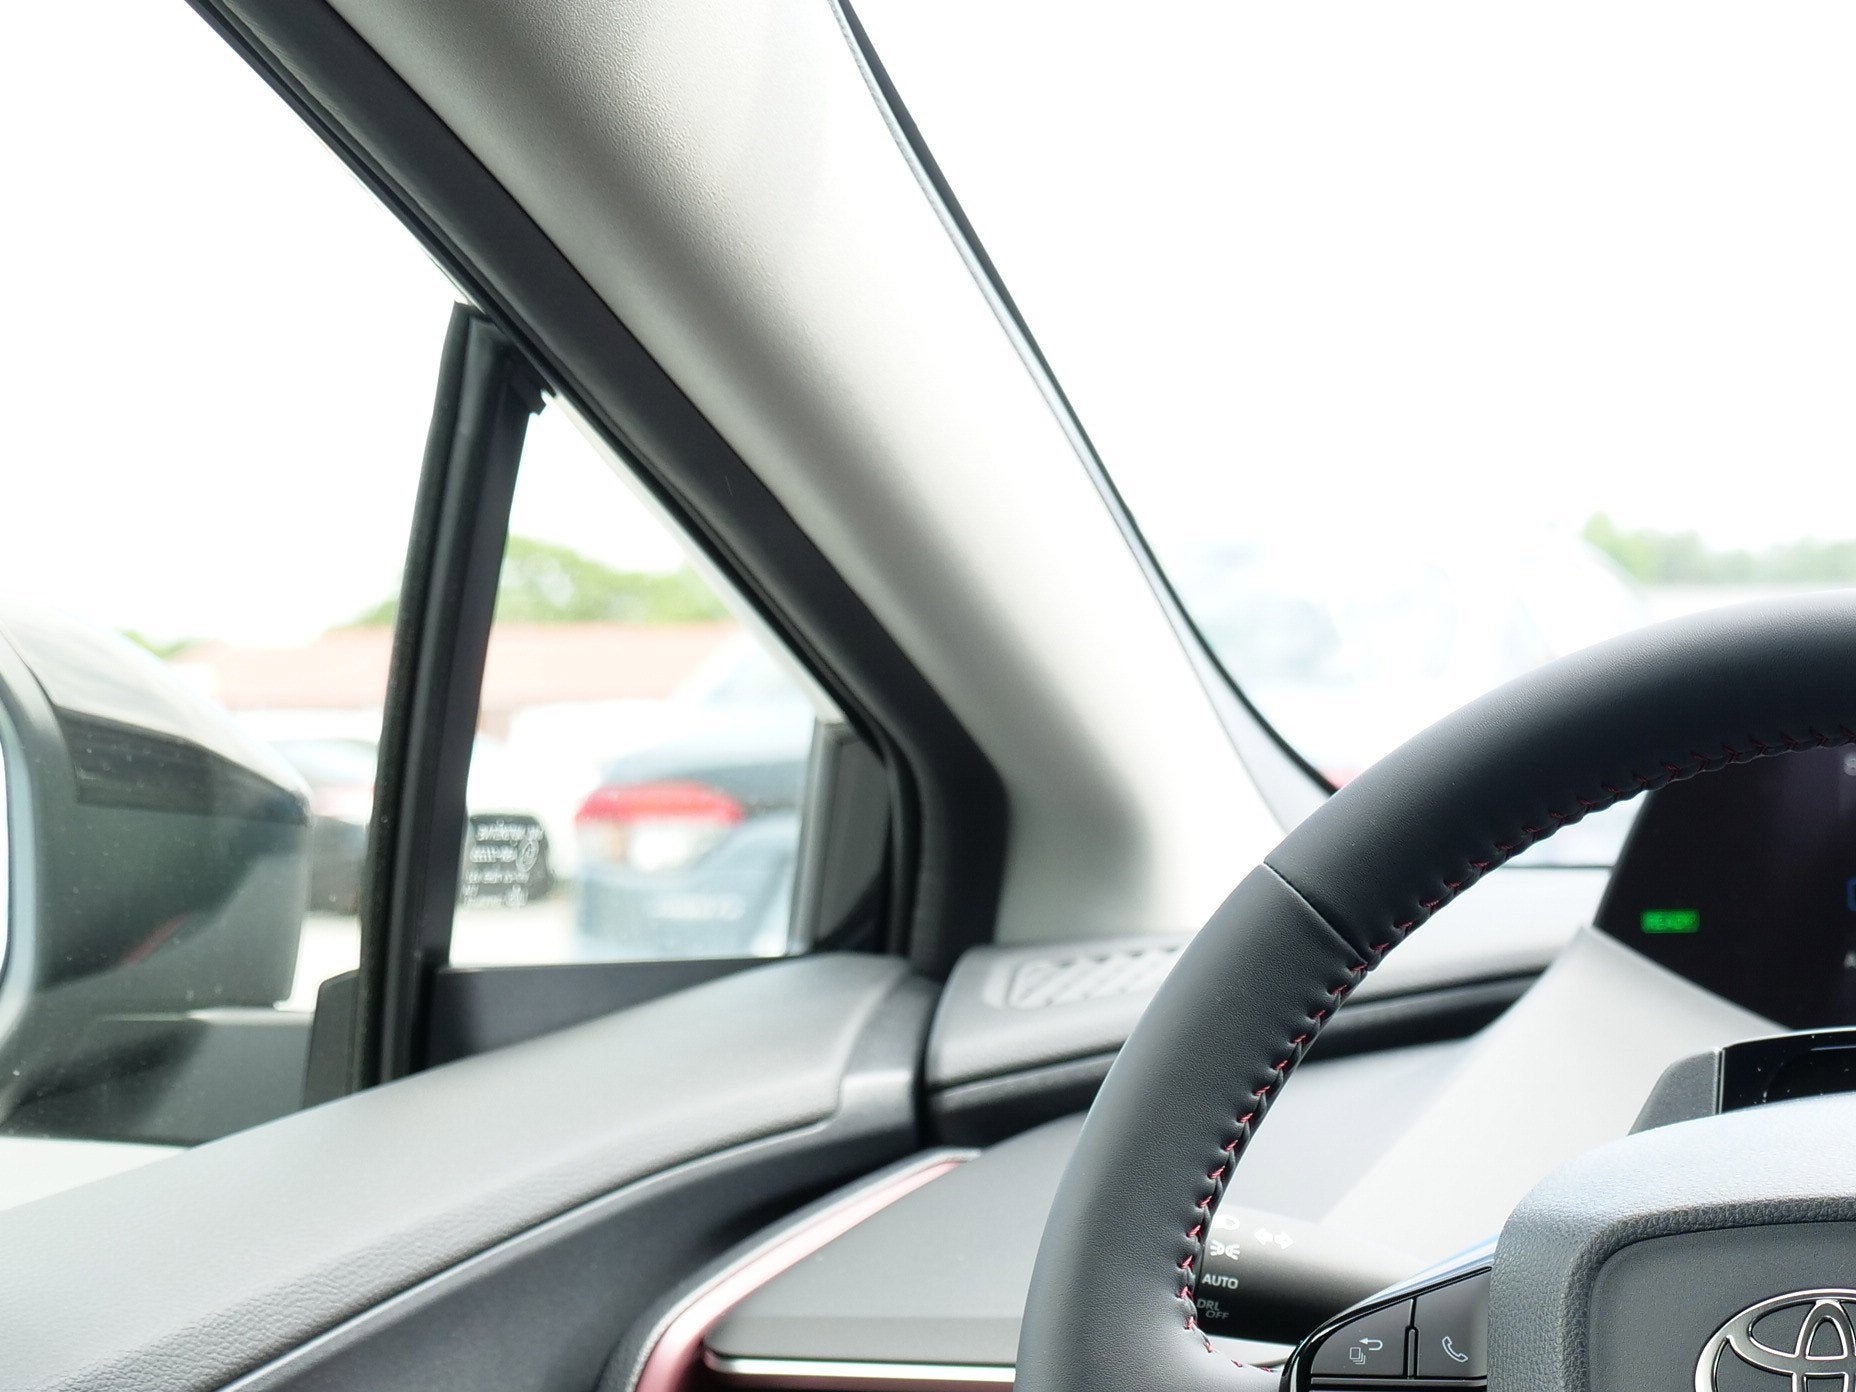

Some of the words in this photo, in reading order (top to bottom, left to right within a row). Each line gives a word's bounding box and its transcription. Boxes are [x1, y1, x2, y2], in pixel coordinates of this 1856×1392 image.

[1202, 1274, 1238, 1290] AUTO
[1197, 1299, 1220, 1311] DRL
[1205, 1310, 1230, 1320] OFF
